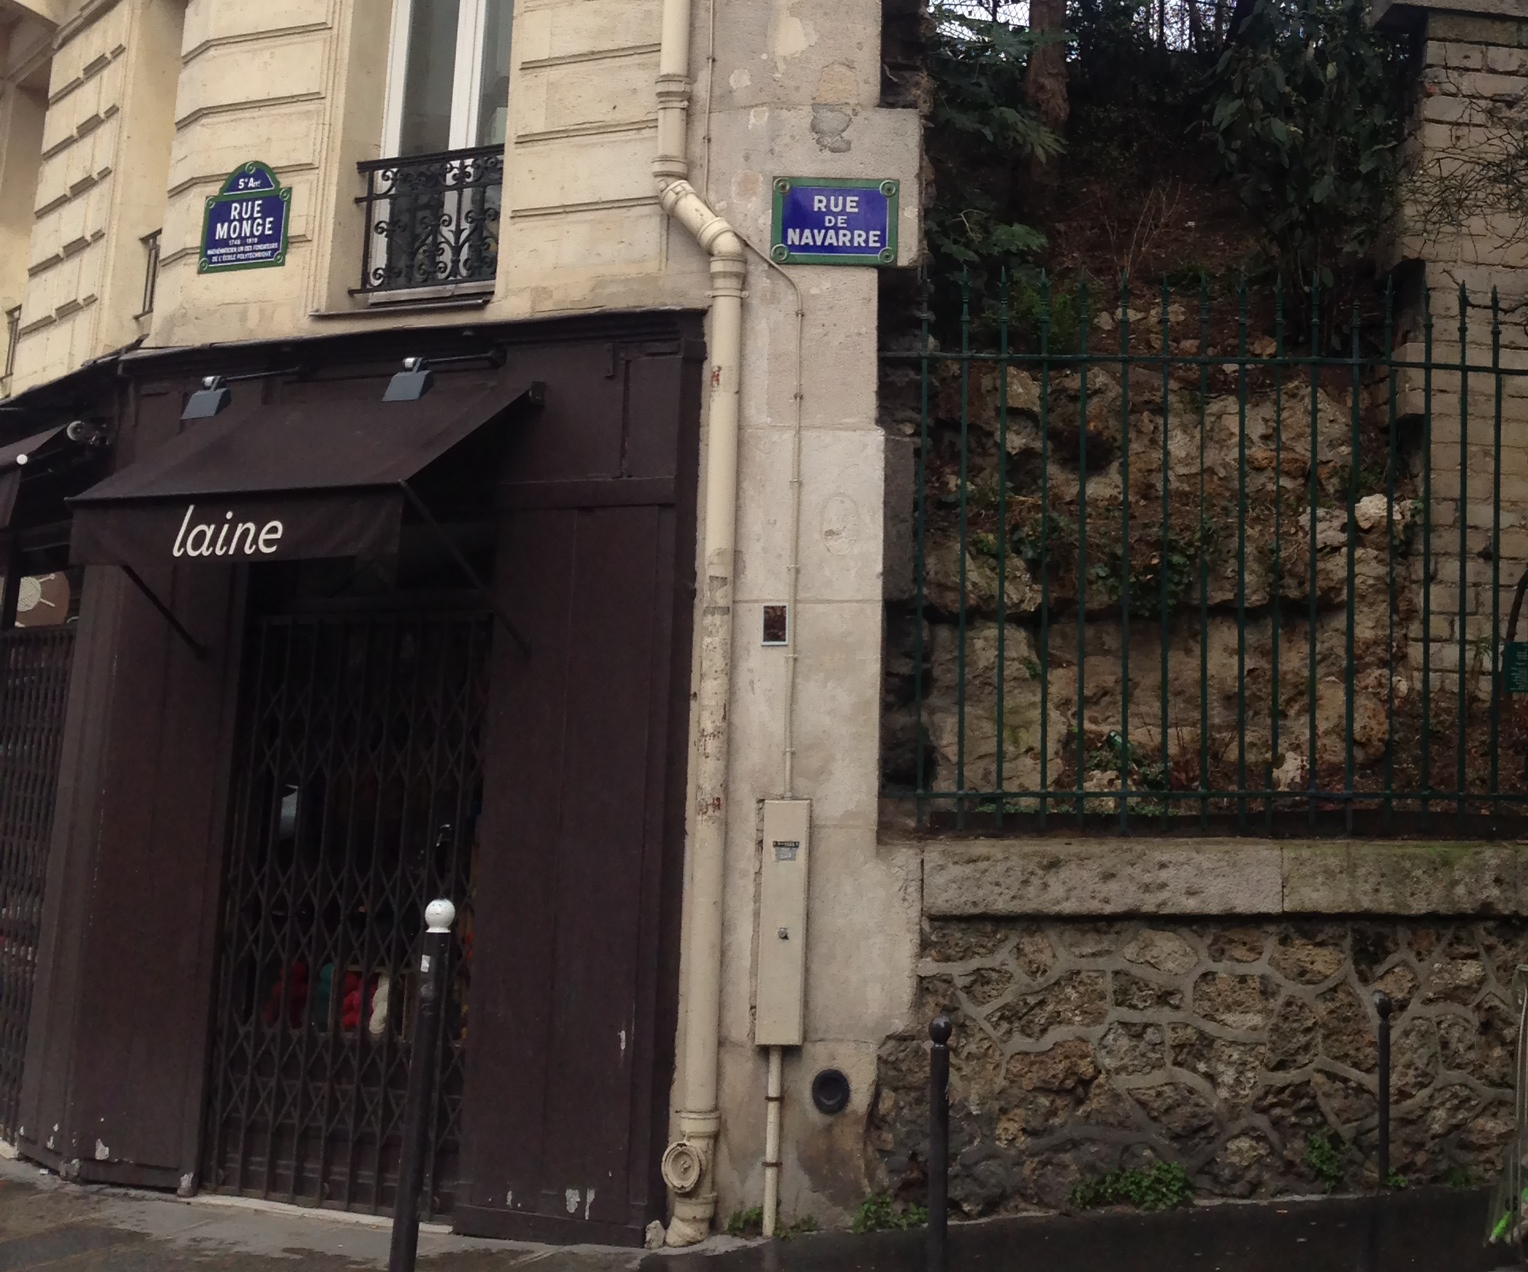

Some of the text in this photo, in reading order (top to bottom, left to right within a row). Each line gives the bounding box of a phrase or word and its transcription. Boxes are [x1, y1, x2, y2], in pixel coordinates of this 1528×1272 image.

[230, 200, 263, 220] RUE
[813, 195, 859, 213] RUE
[215, 217, 274, 240] MONGE
[824, 215, 848, 227] DE
[787, 228, 881, 247] NAVARRE
[172, 504, 284, 557] laine
